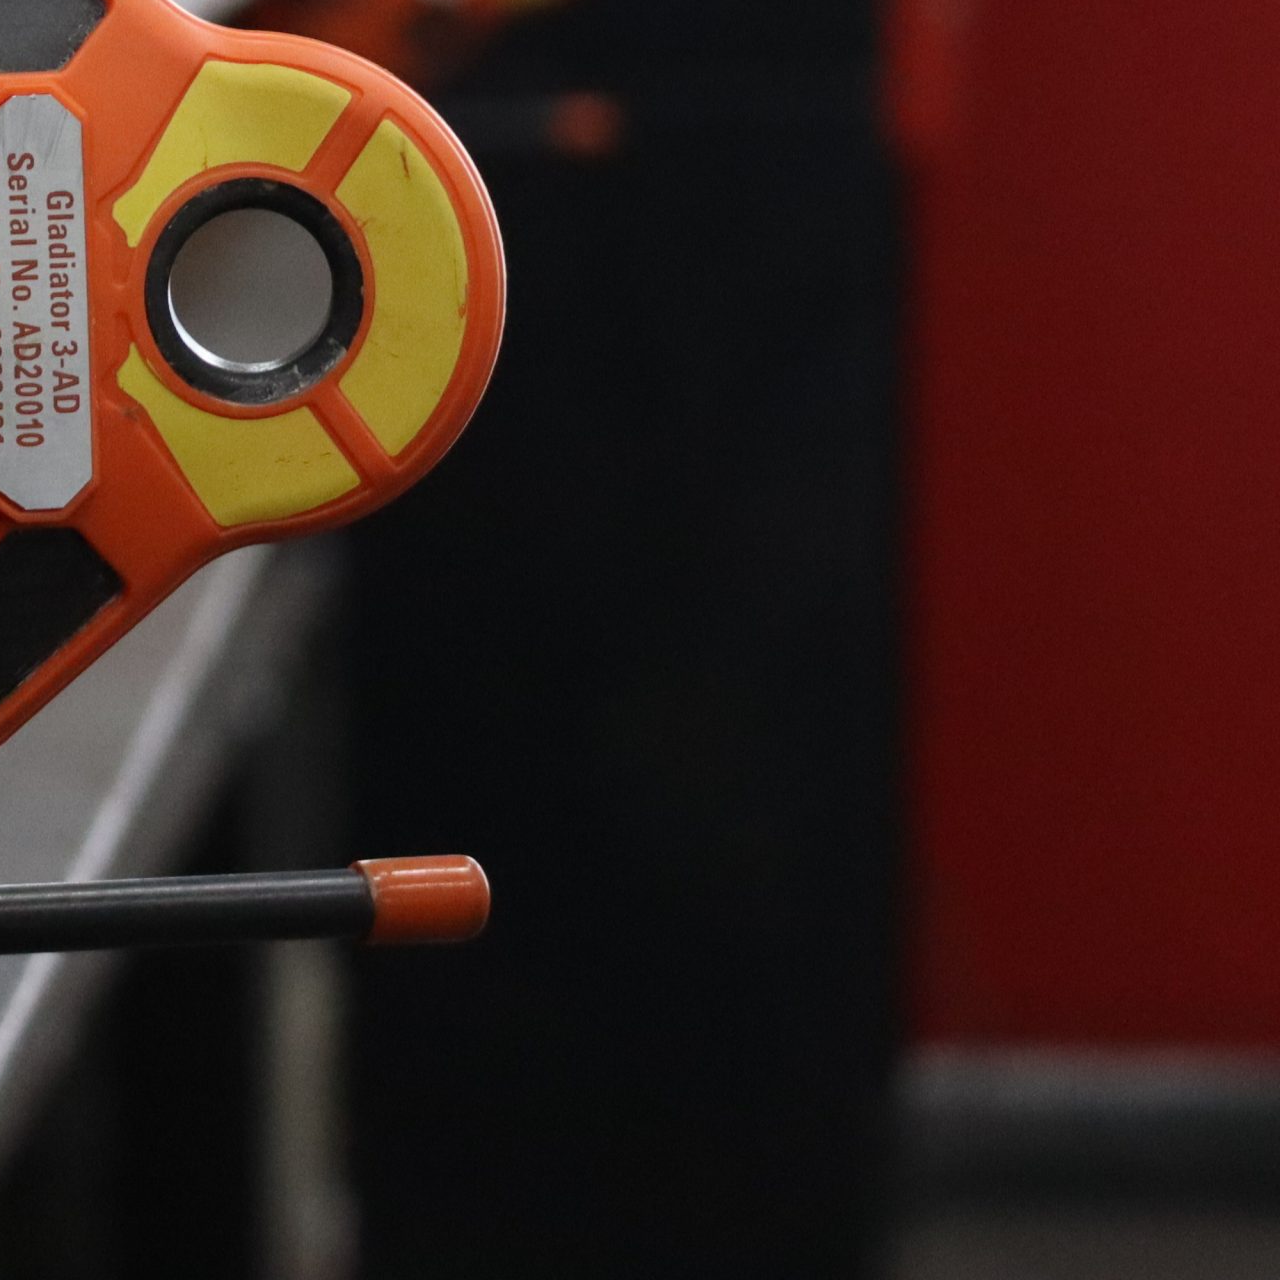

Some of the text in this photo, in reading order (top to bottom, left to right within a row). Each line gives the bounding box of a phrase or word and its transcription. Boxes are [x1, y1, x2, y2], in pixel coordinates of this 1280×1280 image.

[7, 152, 45, 448] Serial No. AD20010
[46, 190, 81, 414] Gladiator 3-AD
